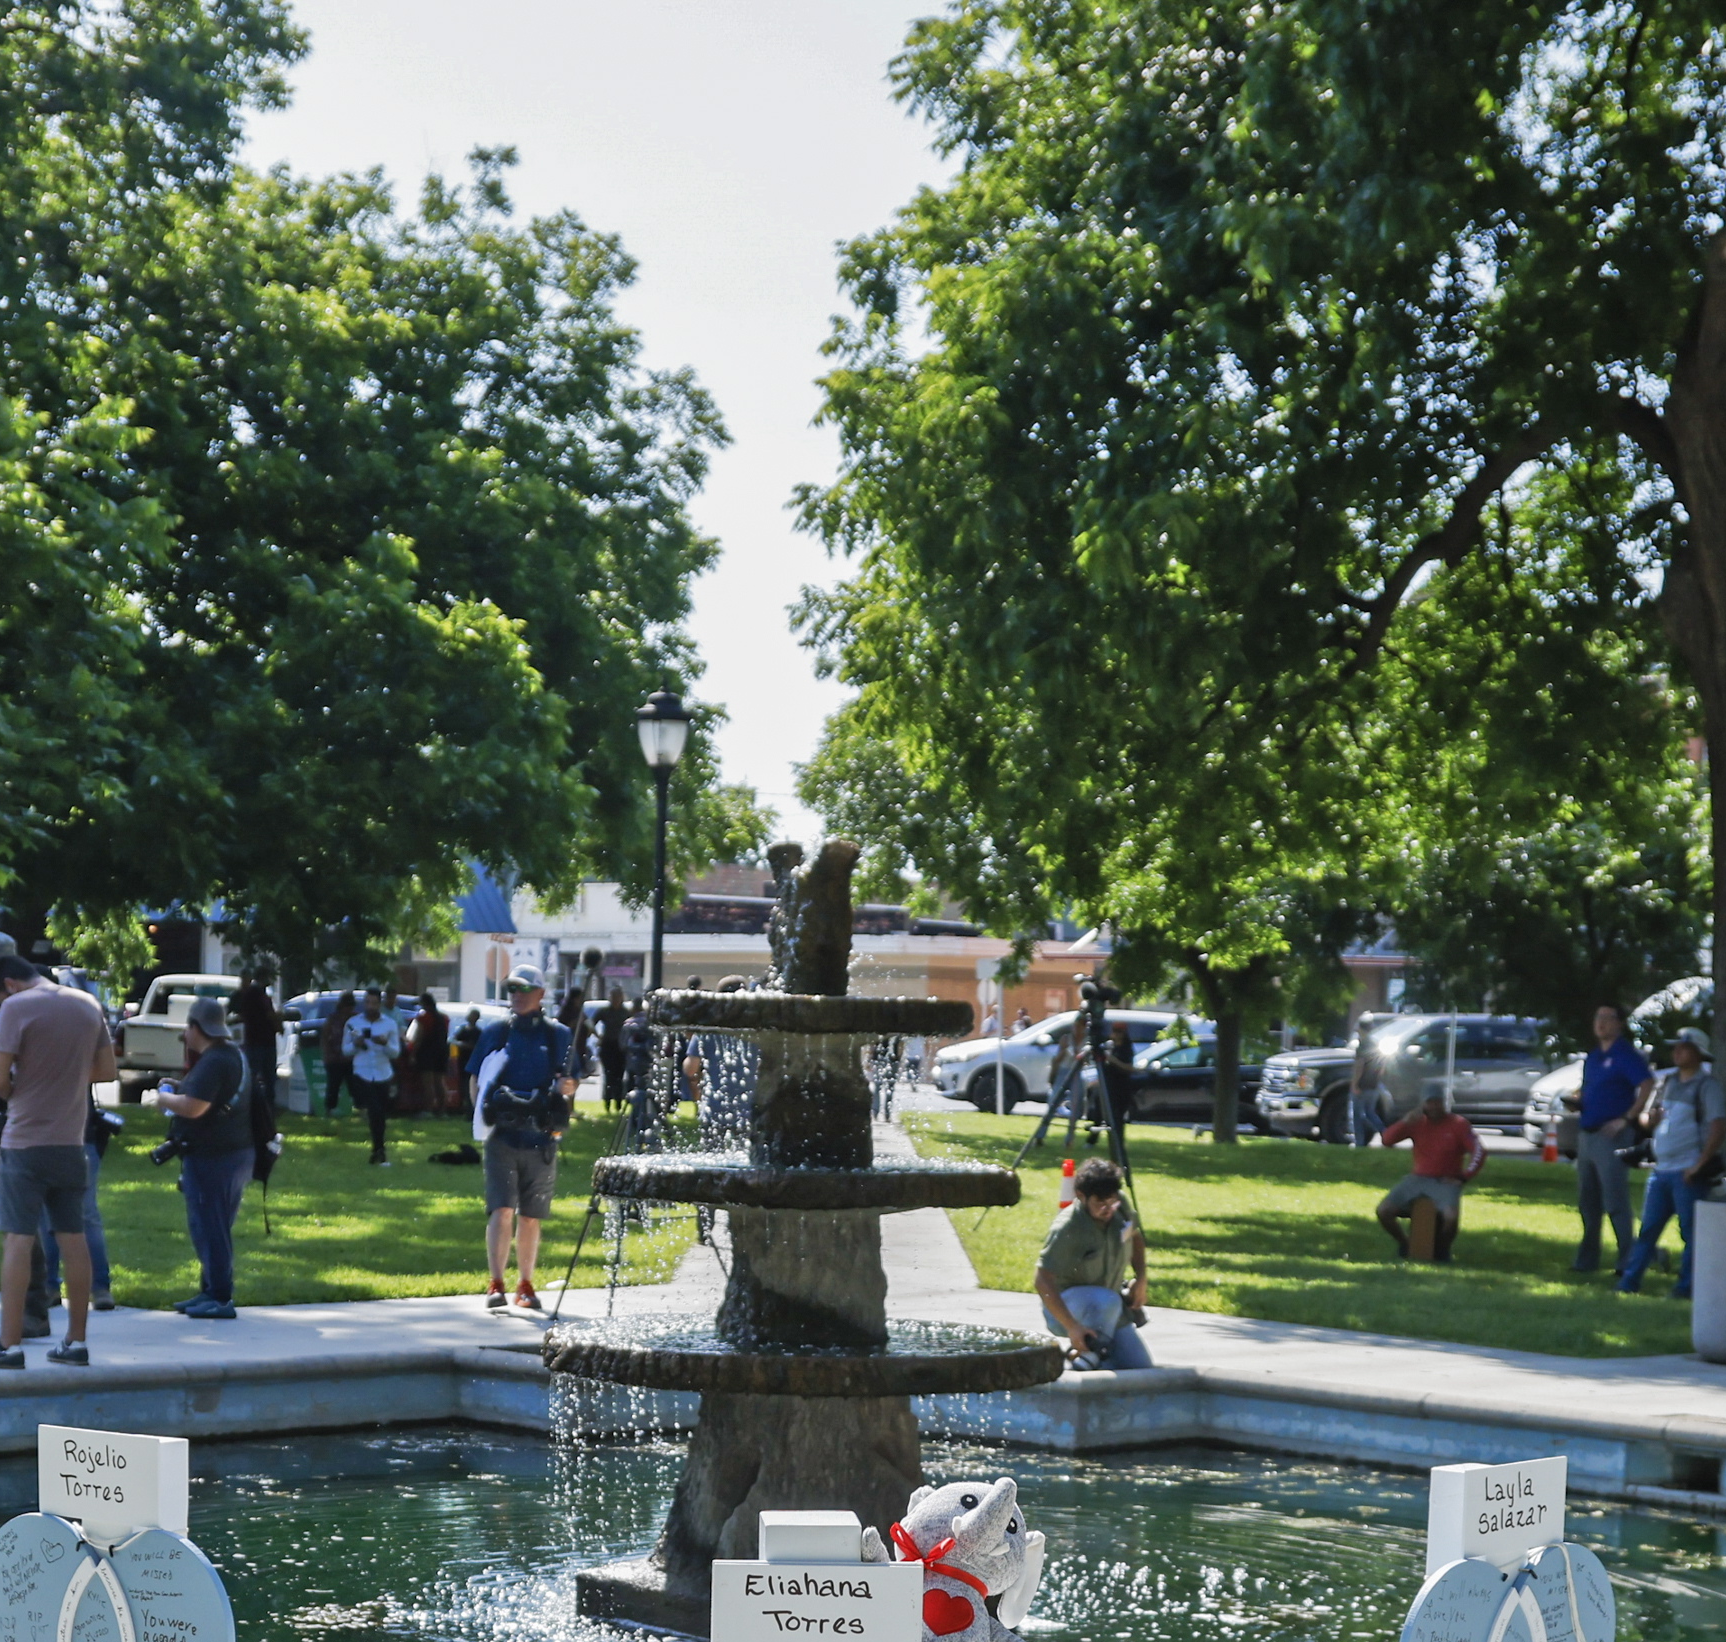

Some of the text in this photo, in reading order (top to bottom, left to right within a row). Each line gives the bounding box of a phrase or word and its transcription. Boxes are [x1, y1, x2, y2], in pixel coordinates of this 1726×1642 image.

[63, 1440, 127, 1473] Rojelio
[60, 1473, 124, 1503] Torres
[1485, 1471, 1534, 1508] Layla
[1479, 1505, 1547, 1534] Salazar
[745, 1572, 873, 1599] Eliahana
[167, 1617, 197, 1636] were
[762, 1610, 865, 1634] Torres
[143, 1631, 150, 1642] a
